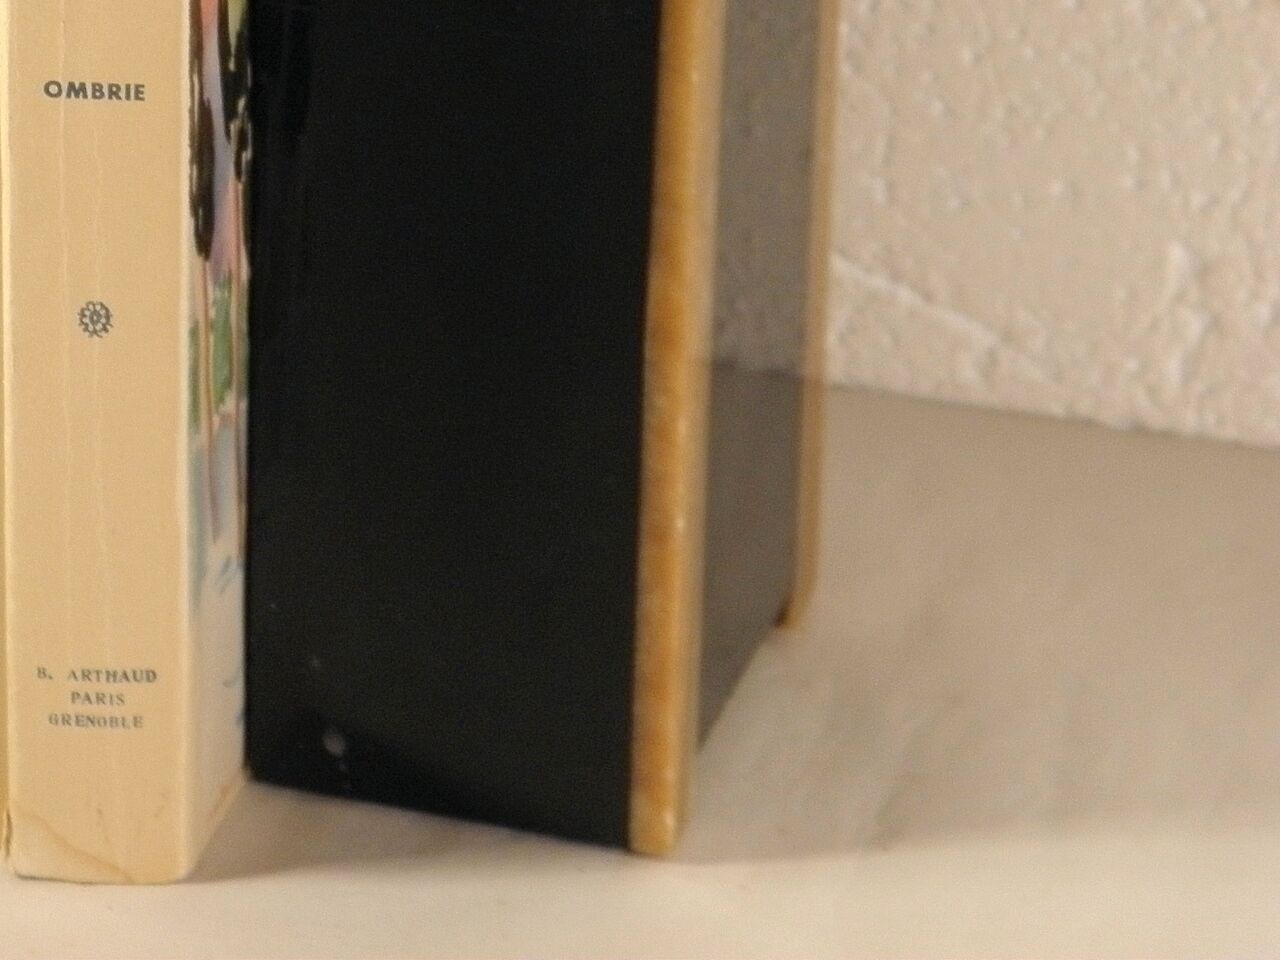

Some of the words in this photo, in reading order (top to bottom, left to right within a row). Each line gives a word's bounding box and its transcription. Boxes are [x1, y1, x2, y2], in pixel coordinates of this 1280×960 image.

[44, 80, 146, 102] OMBRIE
[36, 666, 54, 681] B.
[66, 666, 158, 684] ARTHAUD
[70, 691, 126, 706] PARIS
[48, 712, 144, 730] GRENOBLE
